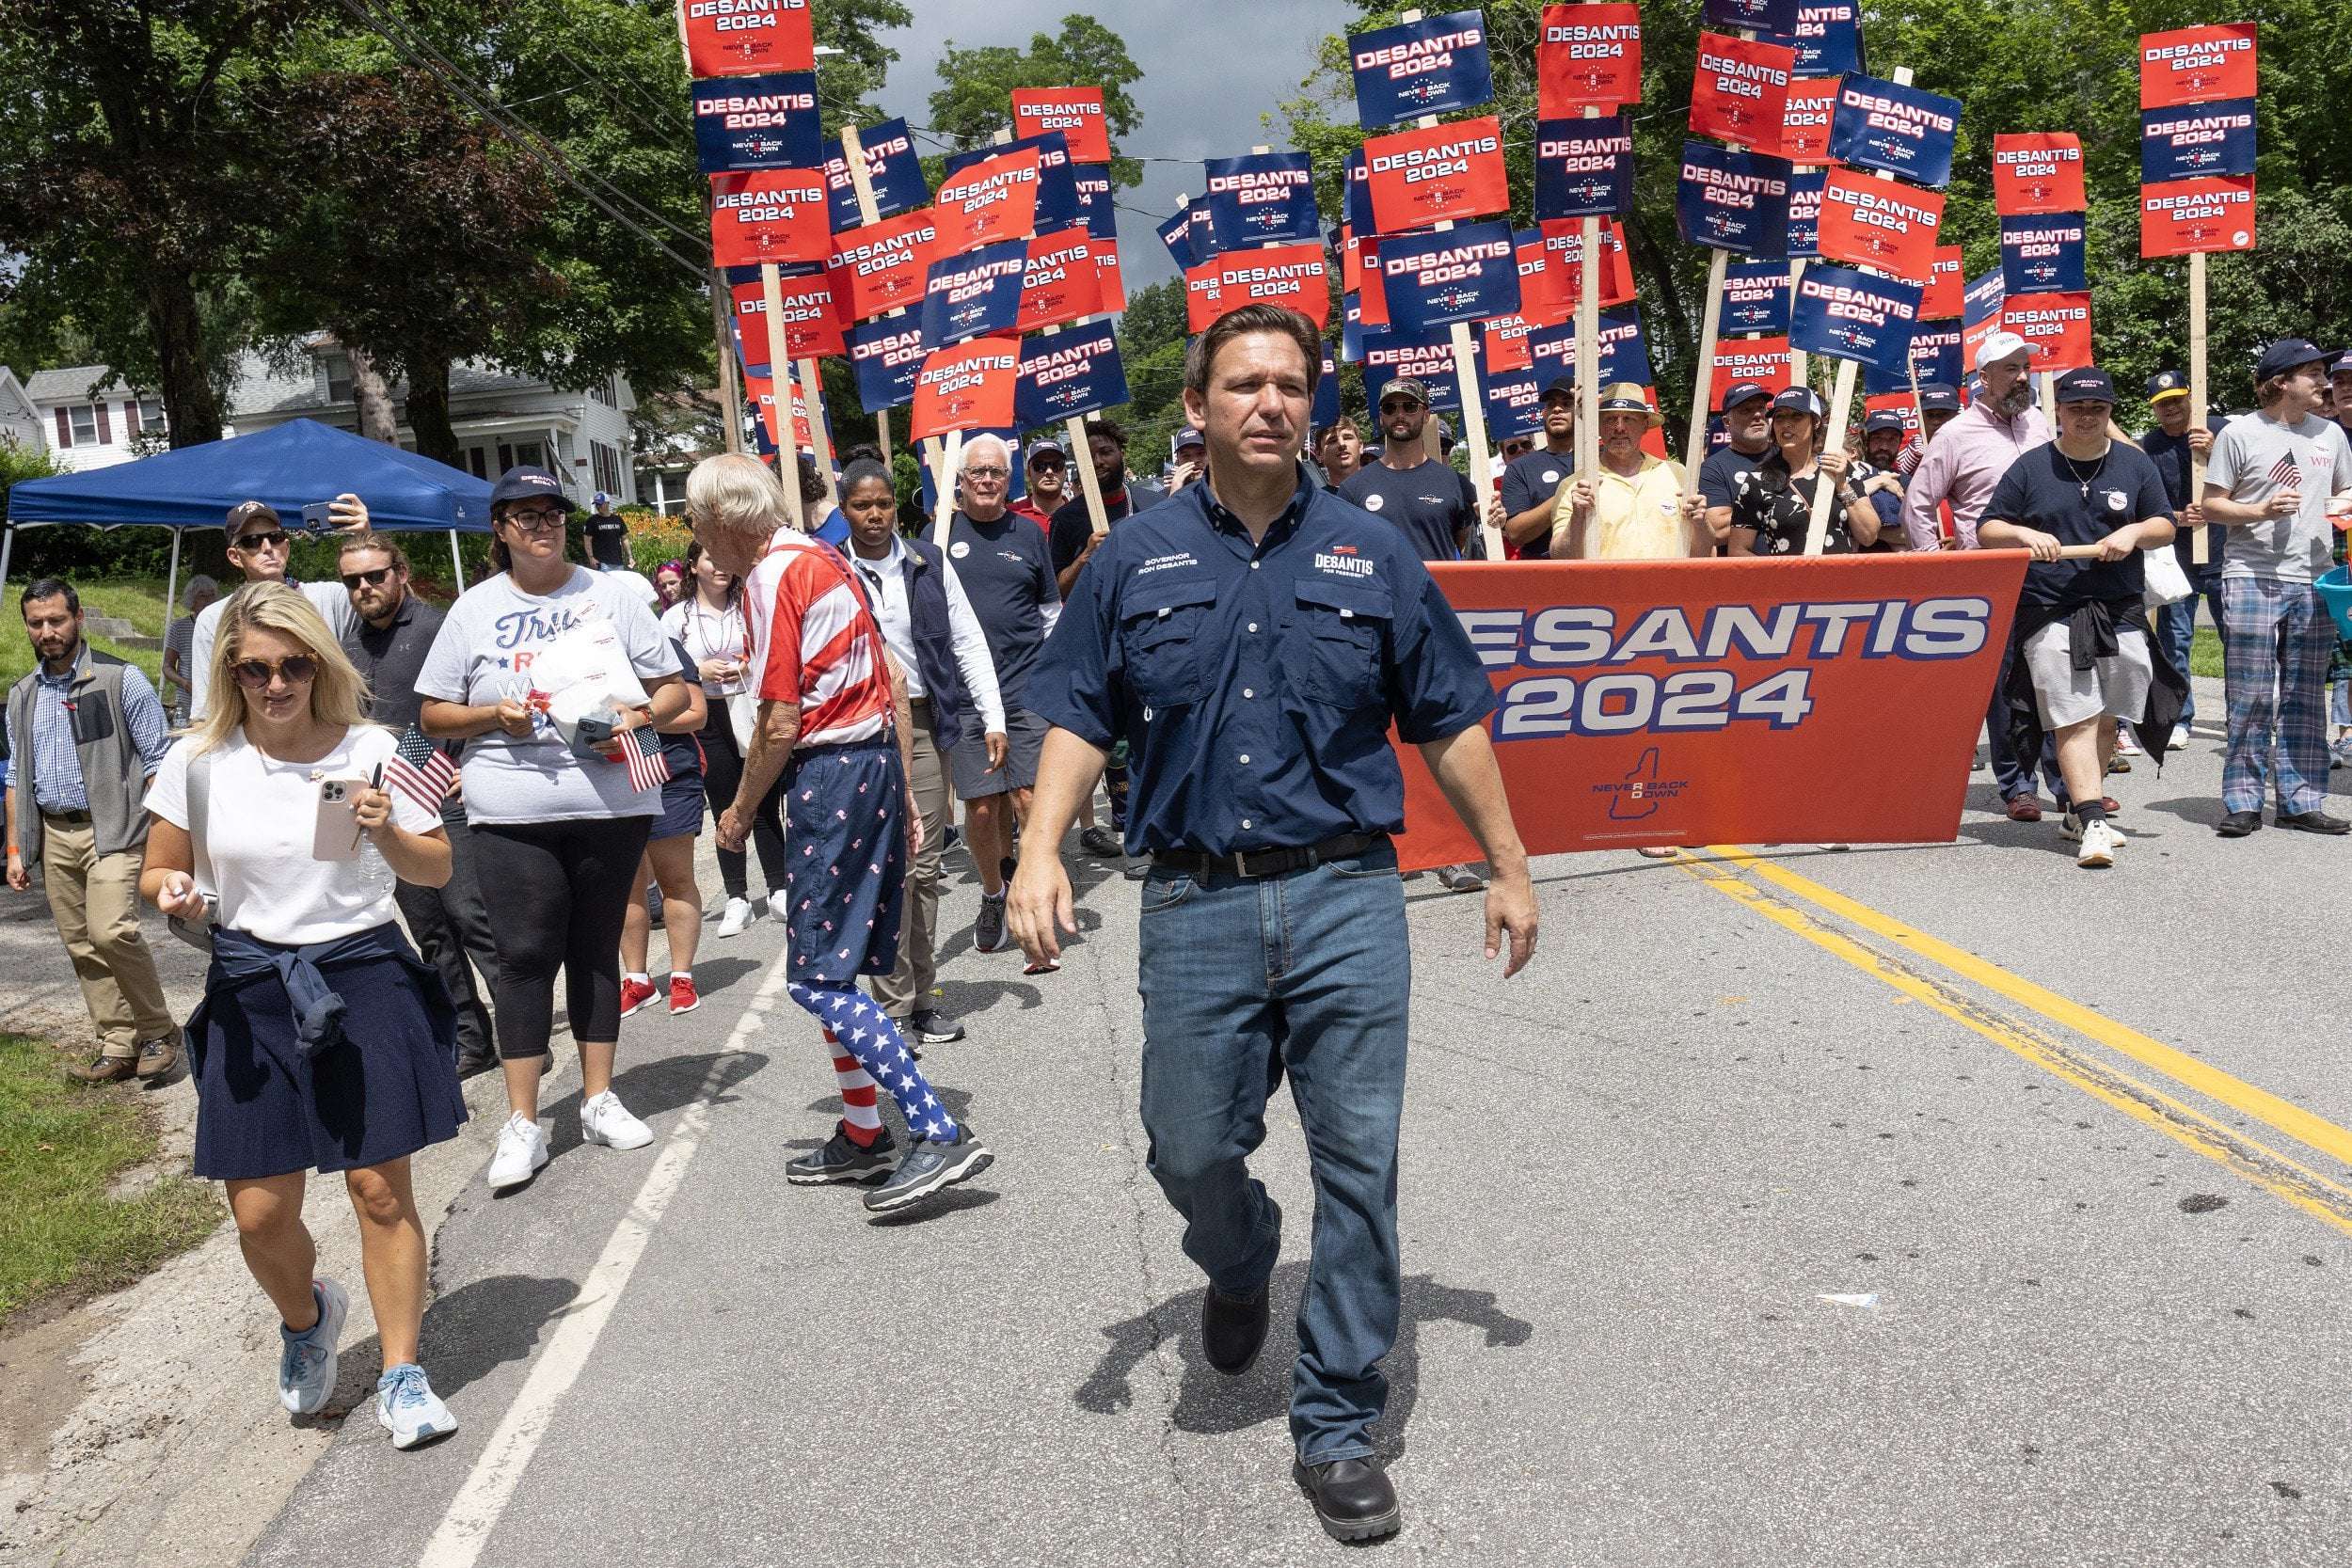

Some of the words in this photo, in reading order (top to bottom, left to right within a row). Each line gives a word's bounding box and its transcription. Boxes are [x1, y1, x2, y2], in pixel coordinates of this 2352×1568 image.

[689, 0, 805, 19] DESANTIS
[1798, 7, 1852, 22] ANTIS
[715, 13, 778, 31] 2024
[1547, 24, 1640, 42] DESANTIS
[1355, 28, 1482, 71] DESANTIS
[1569, 42, 1624, 59] 2024
[2145, 38, 2252, 62] DESANTIS
[1389, 52, 1454, 81] 2024
[1700, 53, 1788, 87] DESANTIS
[2171, 53, 2226, 71] 2024
[1398, 87, 1426, 99] NEVER
[1426, 82, 1451, 90] BACK
[1421, 87, 1447, 99] DOWN
[1716, 76, 1762, 100] 2024
[697, 94, 815, 115] DESANTIS
[1019, 103, 1102, 117] DESANTIS
[1843, 89, 1954, 133] DESANTIS
[725, 112, 787, 130] 2024
[1041, 117, 1084, 129] 2024
[1867, 113, 1925, 140] 2024
[2145, 114, 2251, 137] DESANTIS
[1539, 136, 1632, 158] DESANTIS
[2171, 130, 2226, 147] 2024
[1371, 136, 1498, 174] DESANTIS
[1565, 155, 1616, 174] 2024
[1996, 148, 2080, 165] DESANTIS
[1405, 158, 1469, 184] 2024
[1681, 164, 1787, 197] DESANTIS
[2015, 164, 2057, 177] 2024
[940, 166, 1036, 204] DESANTIS
[1209, 170, 1310, 193] DESANTIS
[715, 188, 823, 209] DESANTIS
[963, 187, 1009, 214] 2024
[1238, 186, 1291, 206] 2024
[1704, 185, 1755, 211] 2024
[1828, 185, 1937, 227] DESANTIS
[2146, 190, 2250, 212] DESANTIS
[738, 206, 795, 223] 2024
[1851, 209, 1909, 235] 2024
[2171, 205, 2226, 221] 2024
[1546, 230, 1613, 251] DESATIS
[2003, 228, 2082, 245] DESANTIS
[827, 226, 936, 269] DESANTIS
[2020, 244, 2061, 258] 2024
[857, 249, 914, 277] 2024
[1025, 245, 1089, 274] ANTIS
[1385, 241, 1511, 277] DESANTIS
[928, 259, 1023, 294] DESANTIS
[1022, 266, 1067, 290] 024
[1222, 261, 1324, 286] DESANTIS
[1418, 261, 1483, 287] 2024
[1723, 275, 1791, 291] ESANTIS
[947, 278, 994, 304] 2024
[1248, 280, 1301, 298] 2024
[1426, 294, 1455, 306] NEVER
[1455, 291, 1480, 299] BACK
[1729, 288, 1774, 302] 2024
[1802, 279, 1914, 320] DESANTIS
[740, 292, 834, 314] DEANTI
[1450, 296, 1476, 306] DOWN
[783, 307, 823, 323] 024
[1827, 302, 1886, 328] 2024
[2004, 308, 2087, 325] DESANTIS
[1829, 328, 1856, 339] NEVER
[1855, 333, 1876, 345] BACK
[1910, 332, 1962, 347] ANTIS
[2024, 323, 2064, 337] 2024
[1534, 324, 1638, 358] DESNTIS
[1849, 336, 1871, 349] DOWN
[1368, 340, 1481, 366] DESANTS
[919, 354, 1015, 386] DESANTIS
[1036, 358, 1091, 388] 2024
[1397, 358, 1454, 377] 2024
[1731, 365, 1776, 378] 2024
[937, 372, 985, 396] 2024
[1509, 392, 1539, 408] 202
[1137, 565, 1155, 576] RON
[1155, 559, 1198, 571] DESANTIS
[1144, 552, 1190, 566] GOVERNOR
[1314, 552, 1374, 576] DESANTIS
[1335, 569, 1365, 578] PRESIDENT
[1454, 595, 1994, 669] ESANTIS
[1494, 668, 1816, 741] 2024
[1592, 782, 1644, 793] NEVER
[1646, 781, 1689, 790] BACK
[1630, 789, 1679, 800] DOWN
